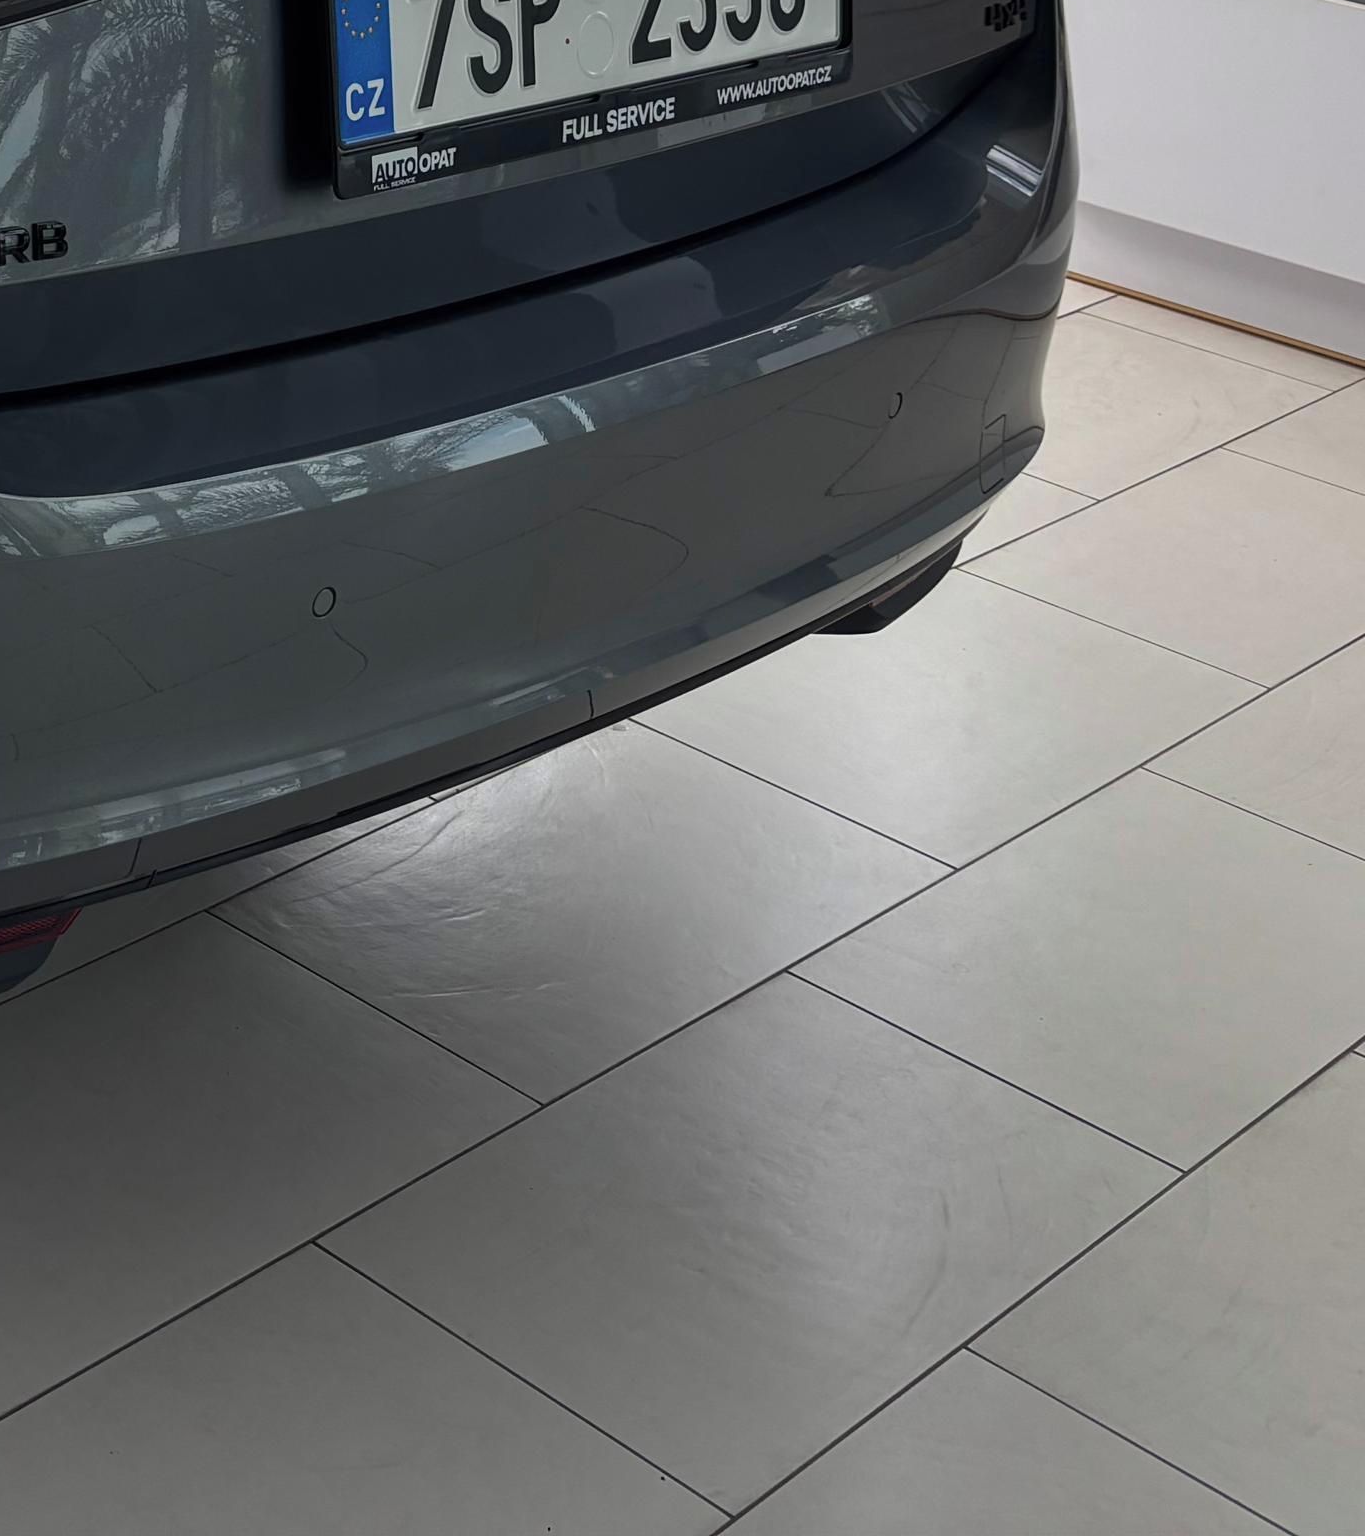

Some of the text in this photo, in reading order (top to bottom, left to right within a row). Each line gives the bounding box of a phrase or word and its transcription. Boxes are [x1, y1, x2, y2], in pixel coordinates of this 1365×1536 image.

[345, 78, 386, 121] CZ
[716, 65, 832, 105] WWW.AUTOOPAT.CZ
[562, 96, 676, 143] FULL SERVICE
